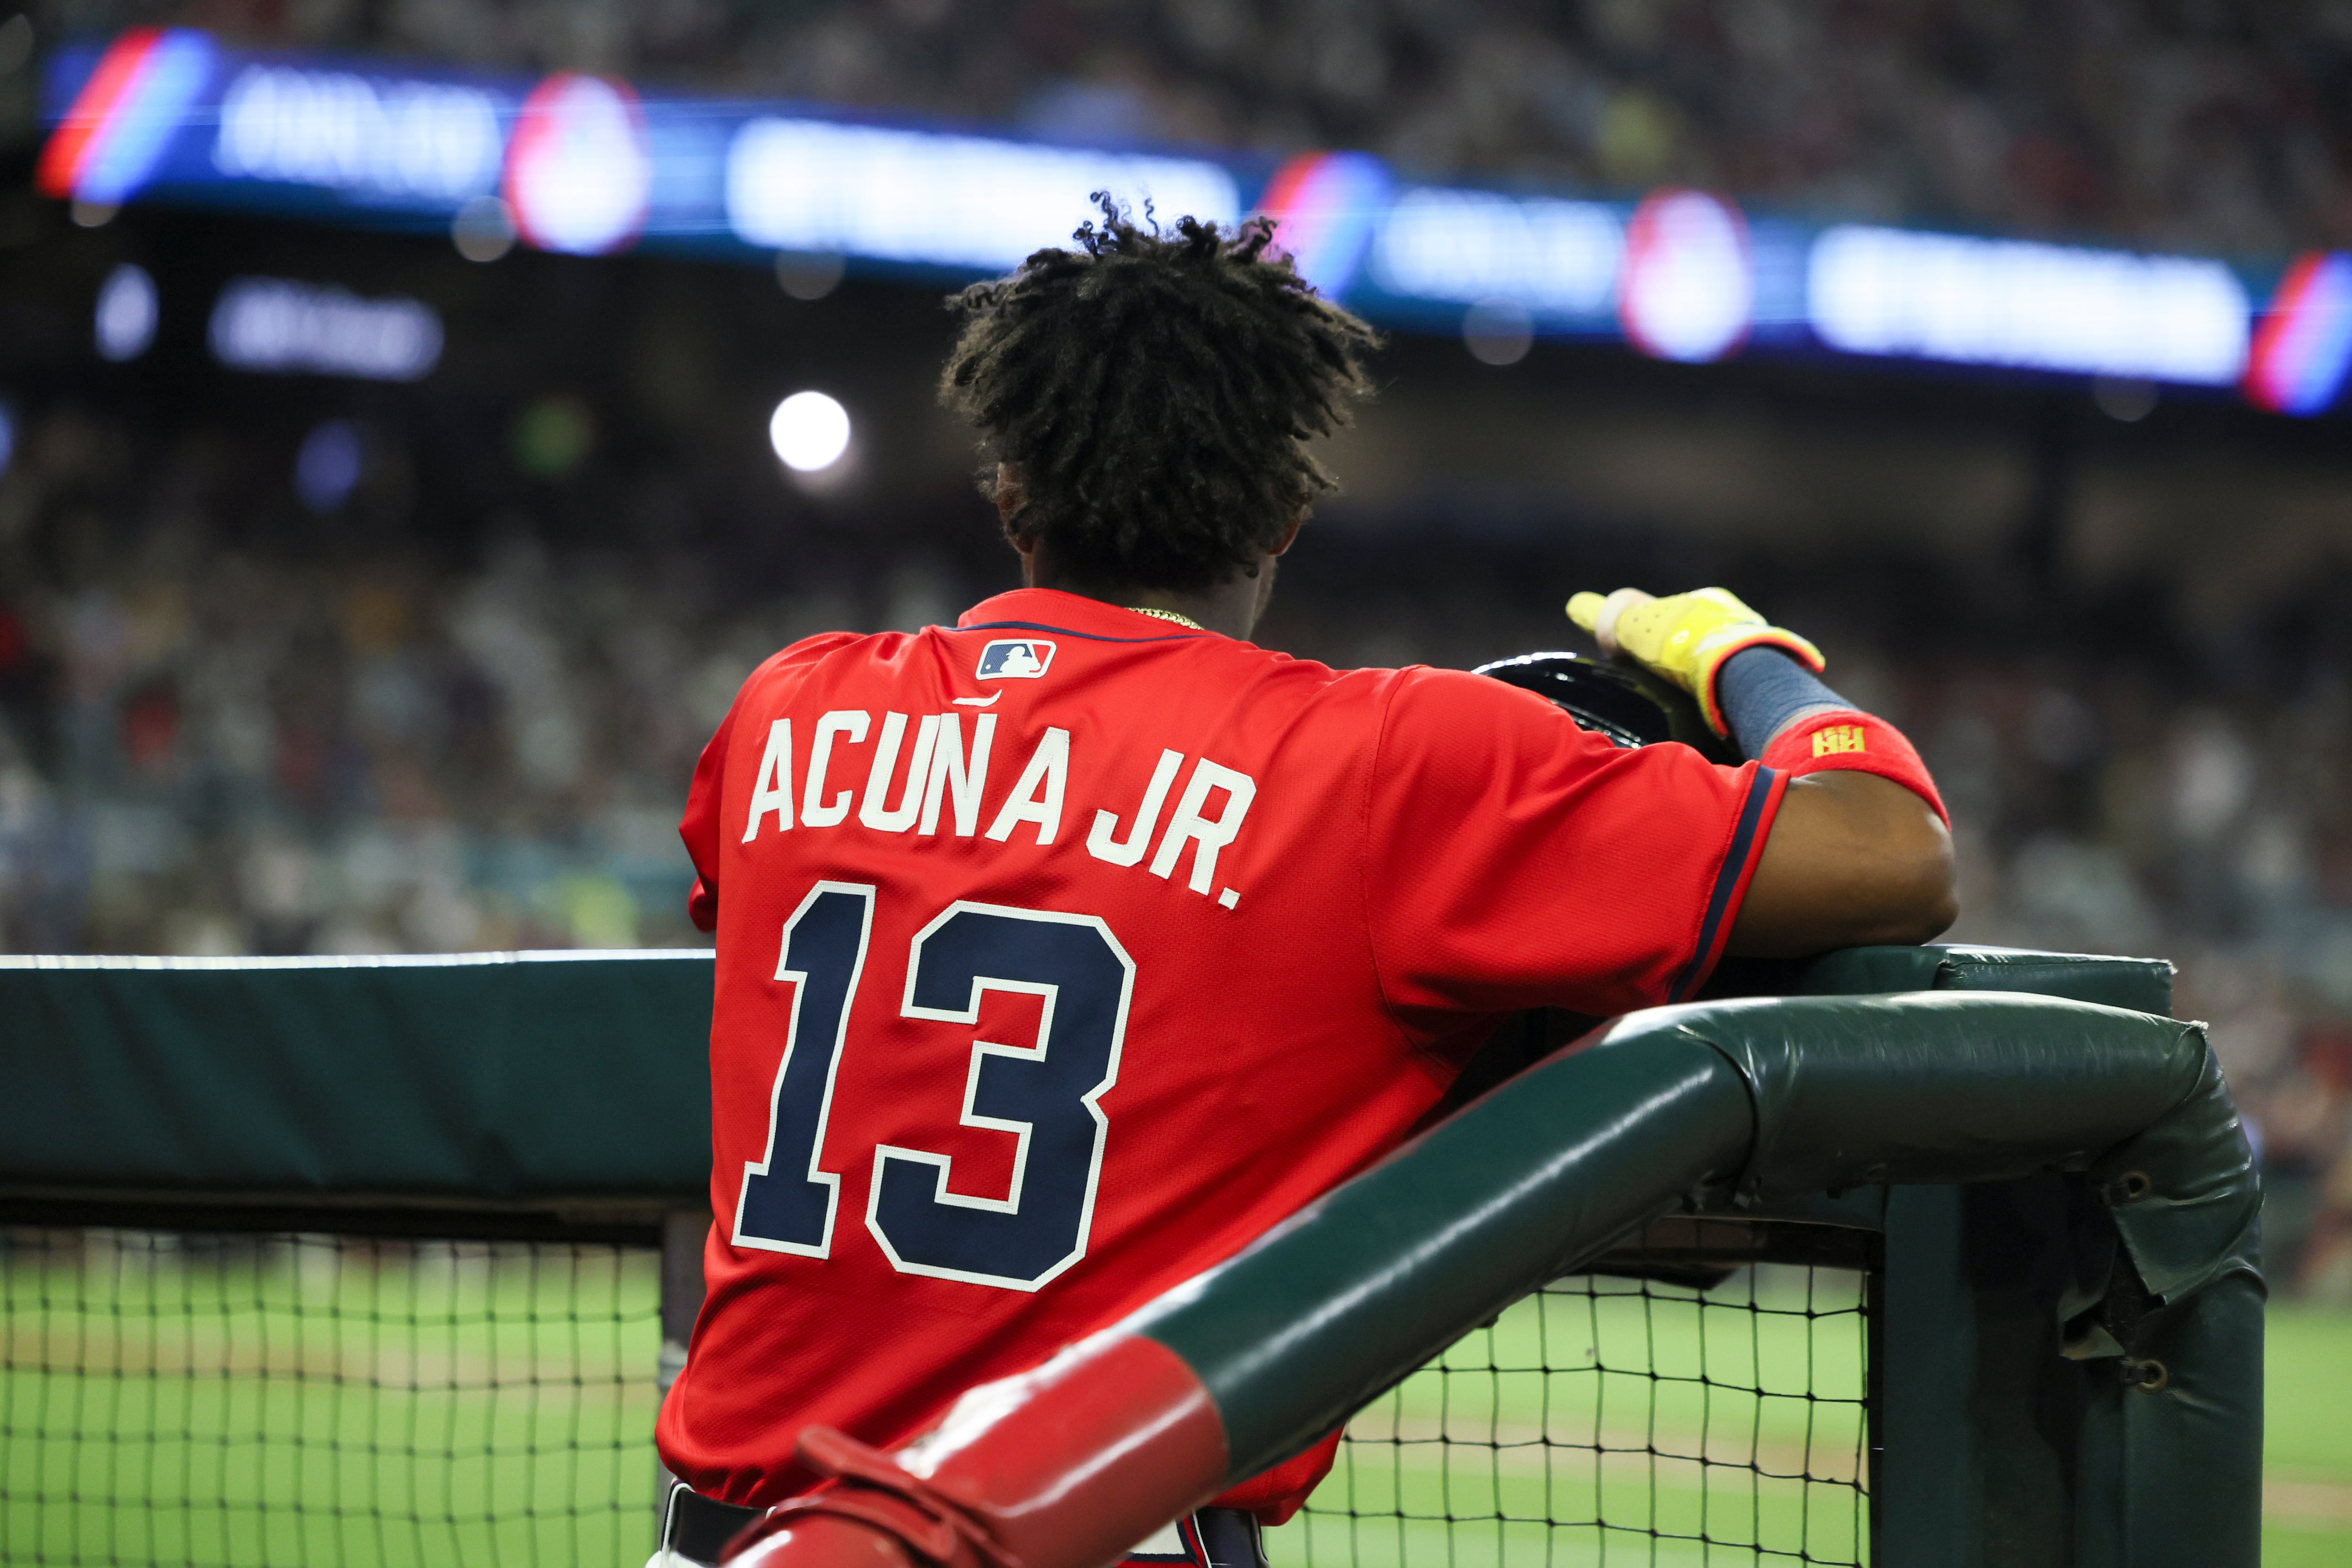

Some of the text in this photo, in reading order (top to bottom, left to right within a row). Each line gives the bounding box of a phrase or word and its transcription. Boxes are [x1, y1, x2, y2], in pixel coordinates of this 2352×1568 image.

[741, 689, 1257, 911] ACUÑA JR.
[731, 880, 1137, 1293] 13
